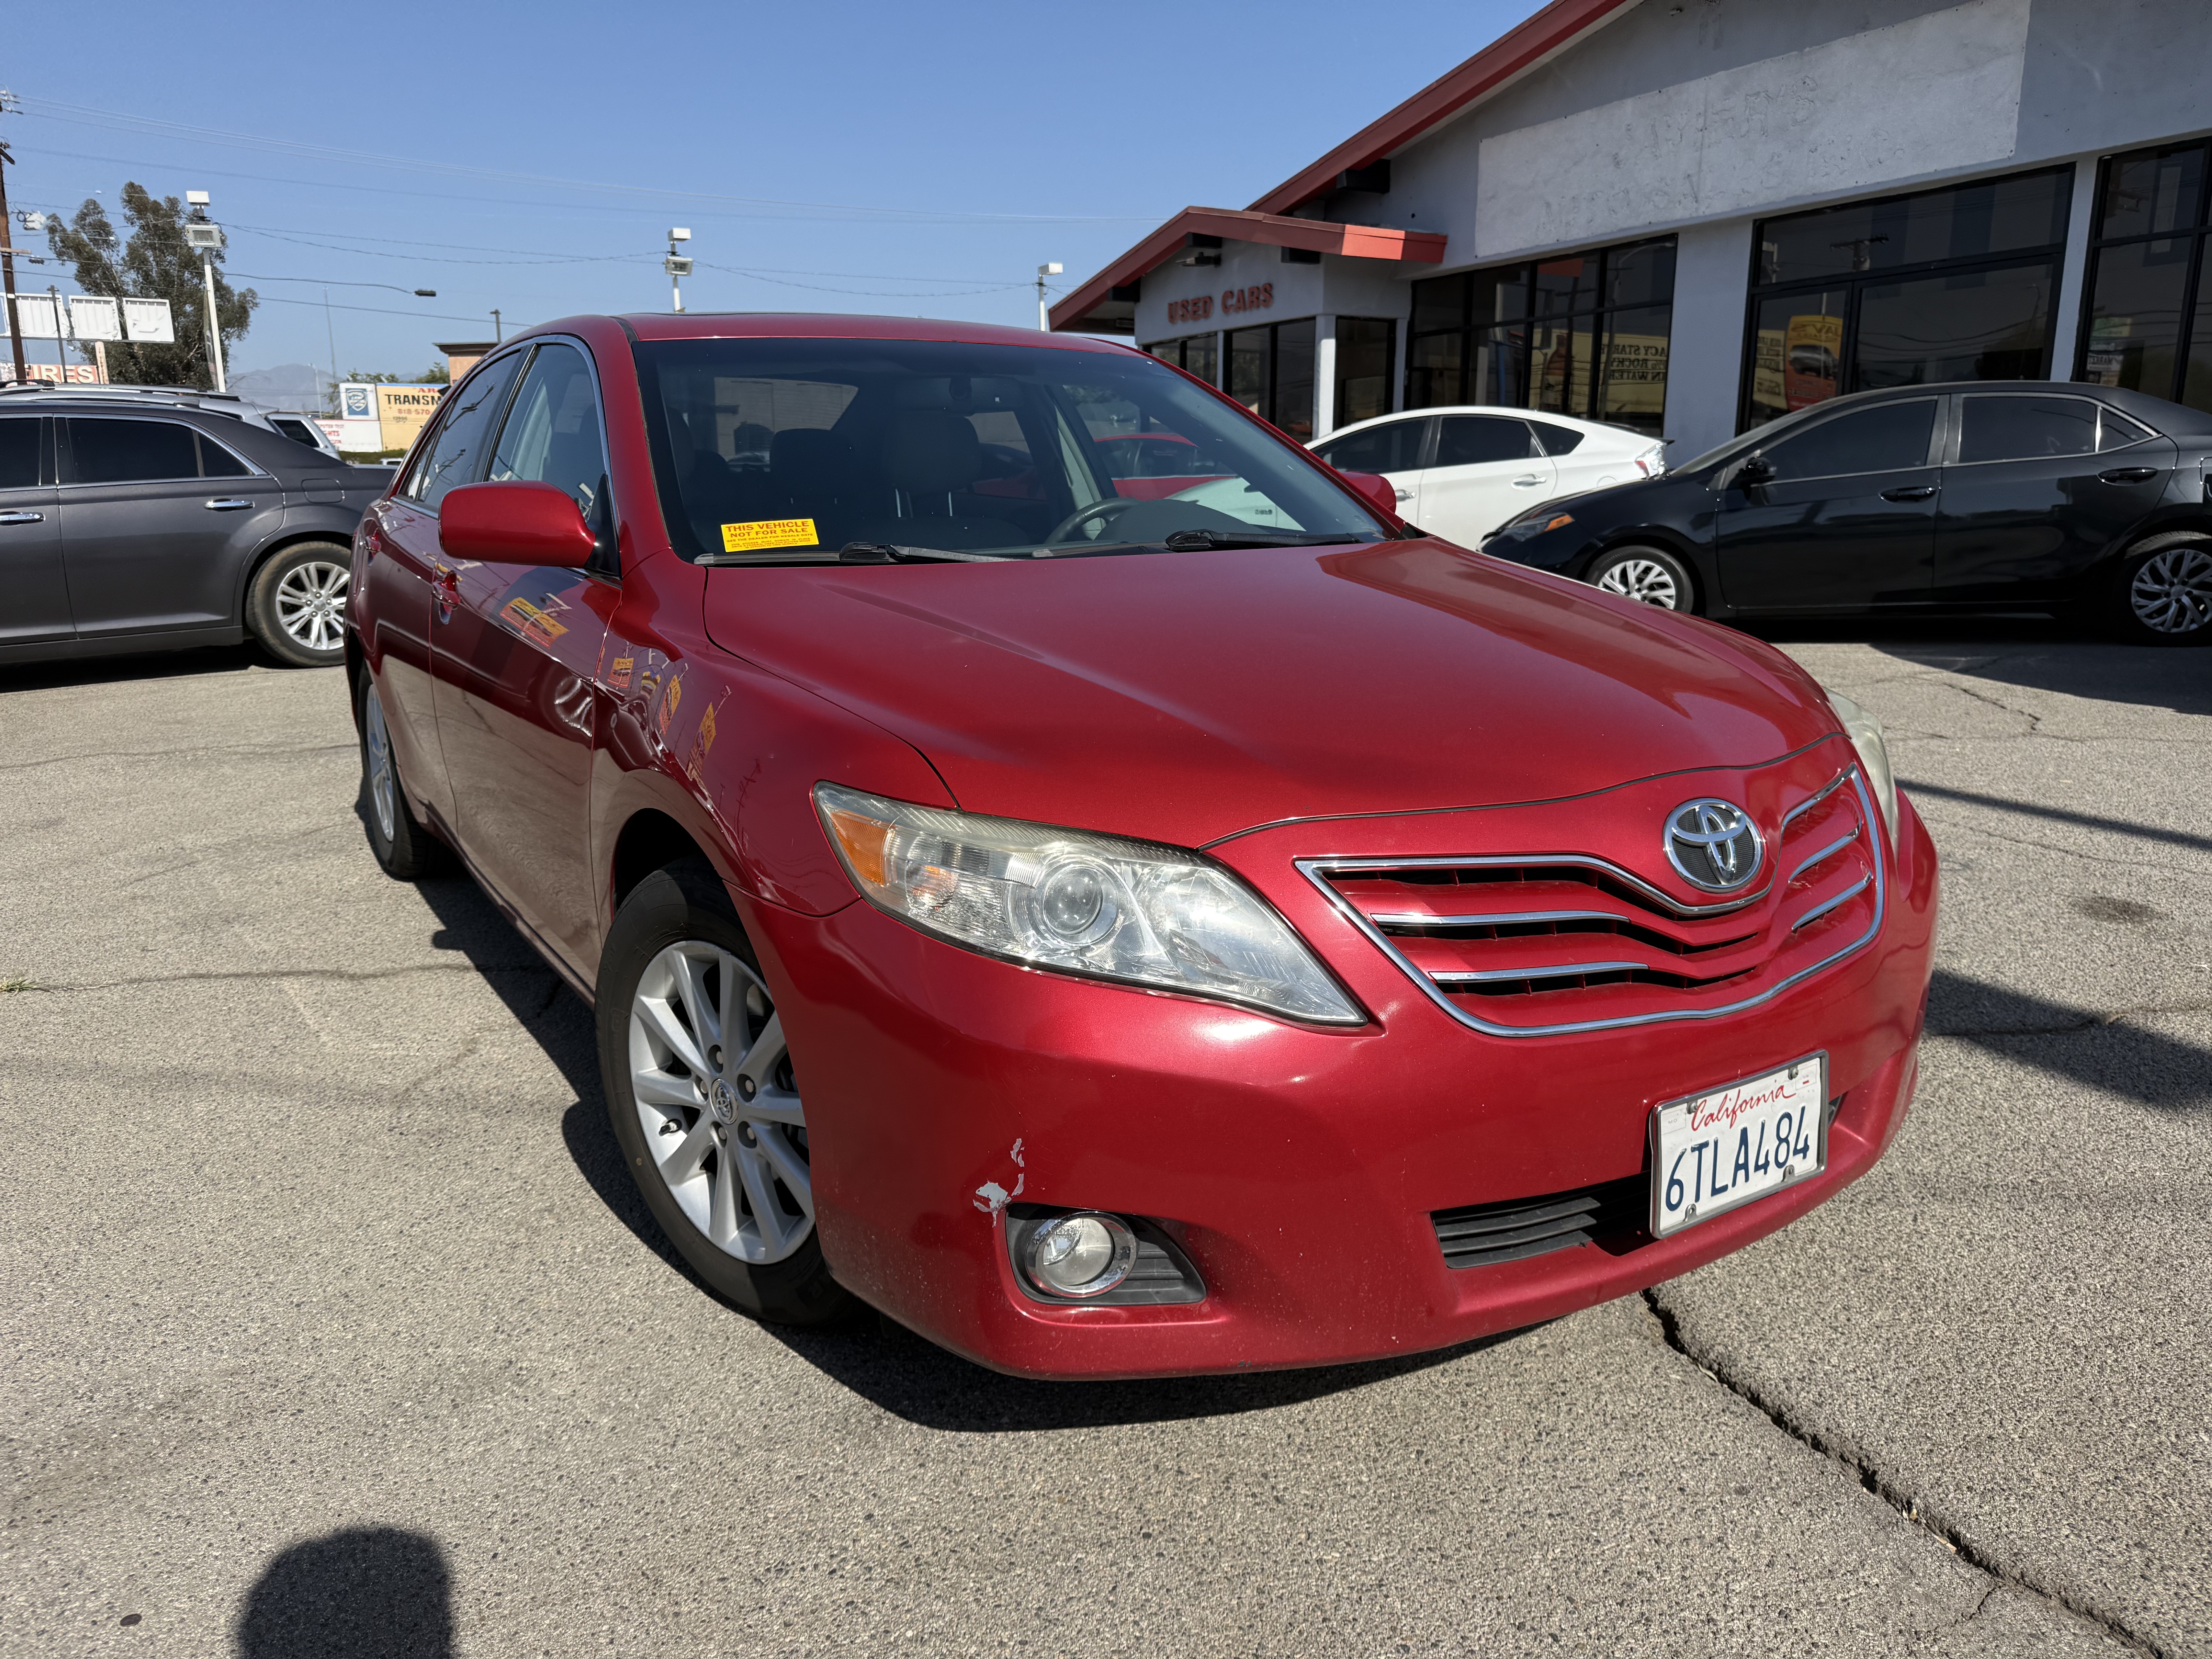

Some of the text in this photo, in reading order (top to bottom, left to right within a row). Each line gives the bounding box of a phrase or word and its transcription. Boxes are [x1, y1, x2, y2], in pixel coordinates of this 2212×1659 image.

[1168, 282, 1273, 324] USED CARS
[757, 521, 809, 530] VEHICLE
[1692, 1080, 1796, 1131] California
[1666, 1105, 1810, 1211] 6TLA484
